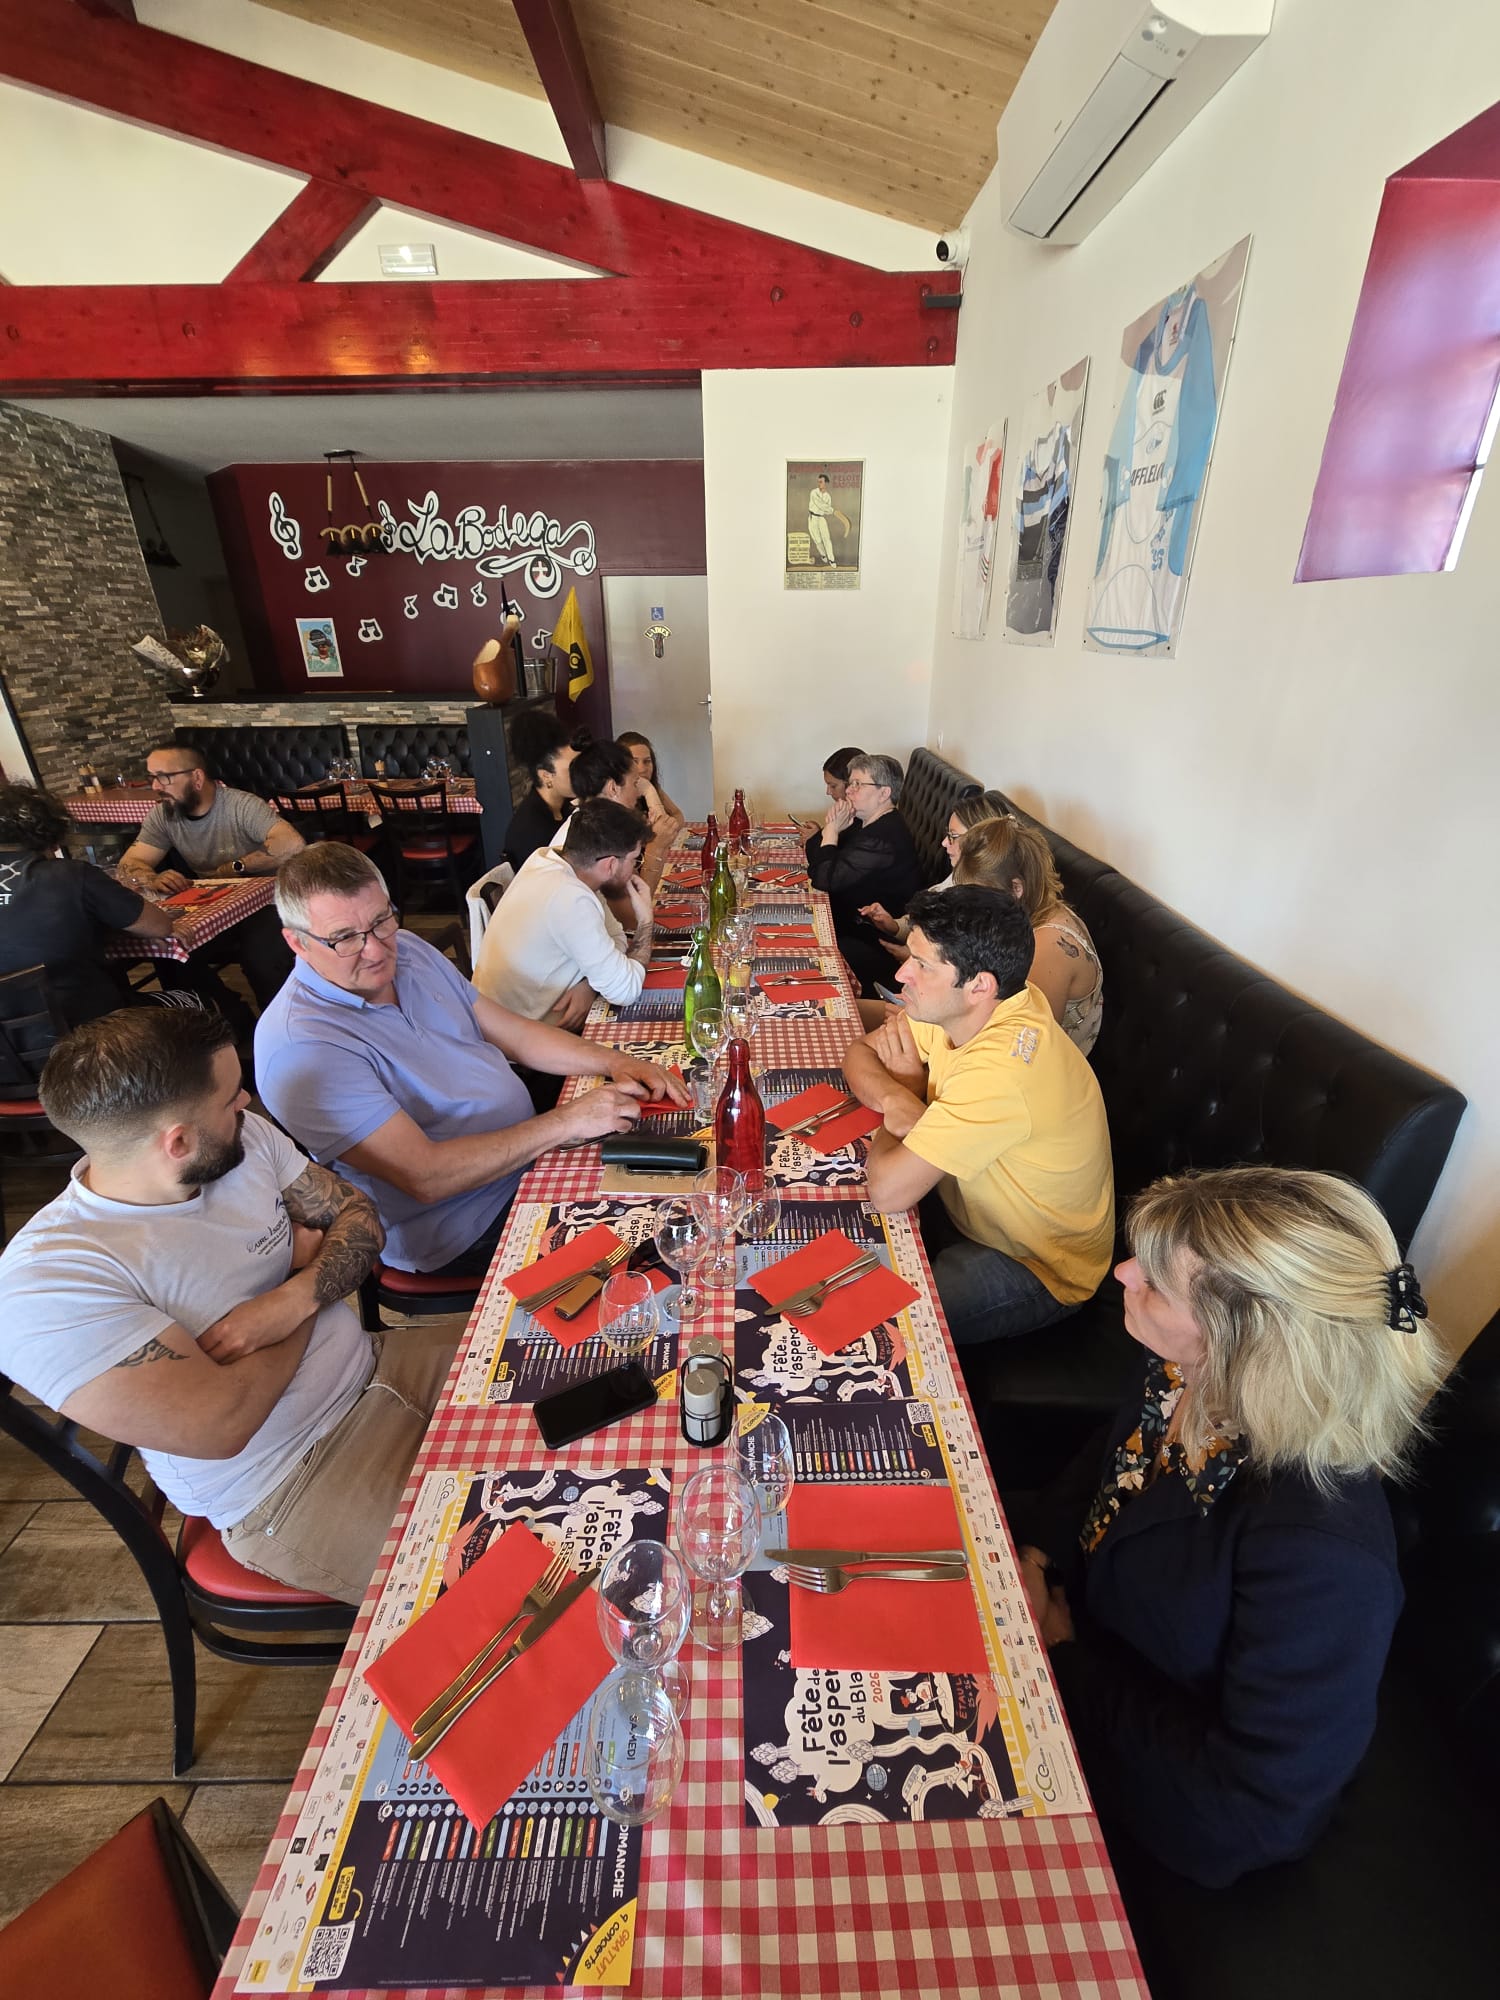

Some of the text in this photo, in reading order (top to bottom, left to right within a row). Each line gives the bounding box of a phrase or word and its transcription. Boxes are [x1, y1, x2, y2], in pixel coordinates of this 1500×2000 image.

[400, 490, 449, 562] La
[646, 626, 671, 638] LADIES
[778, 1150, 790, 1168] Fête
[642, 1218, 654, 1238] Fête
[662, 1342, 670, 1370] DIMANCHE
[770, 1344, 788, 1373] Fête
[790, 1321, 806, 1380] l'asperg
[808, 1352, 817, 1360] du
[565, 1526, 577, 1538] du
[596, 1508, 622, 1568] Fête de
[870, 1672, 884, 1704] 2026
[796, 1669, 825, 1752] Fête de
[850, 1706, 866, 1724] du
[626, 1715, 638, 1760] SAMEDI
[612, 1824, 628, 1900] DIMANCHE
[584, 1913, 628, 1970] 9 concerts
[597, 1930, 630, 1978] GRATUIT
